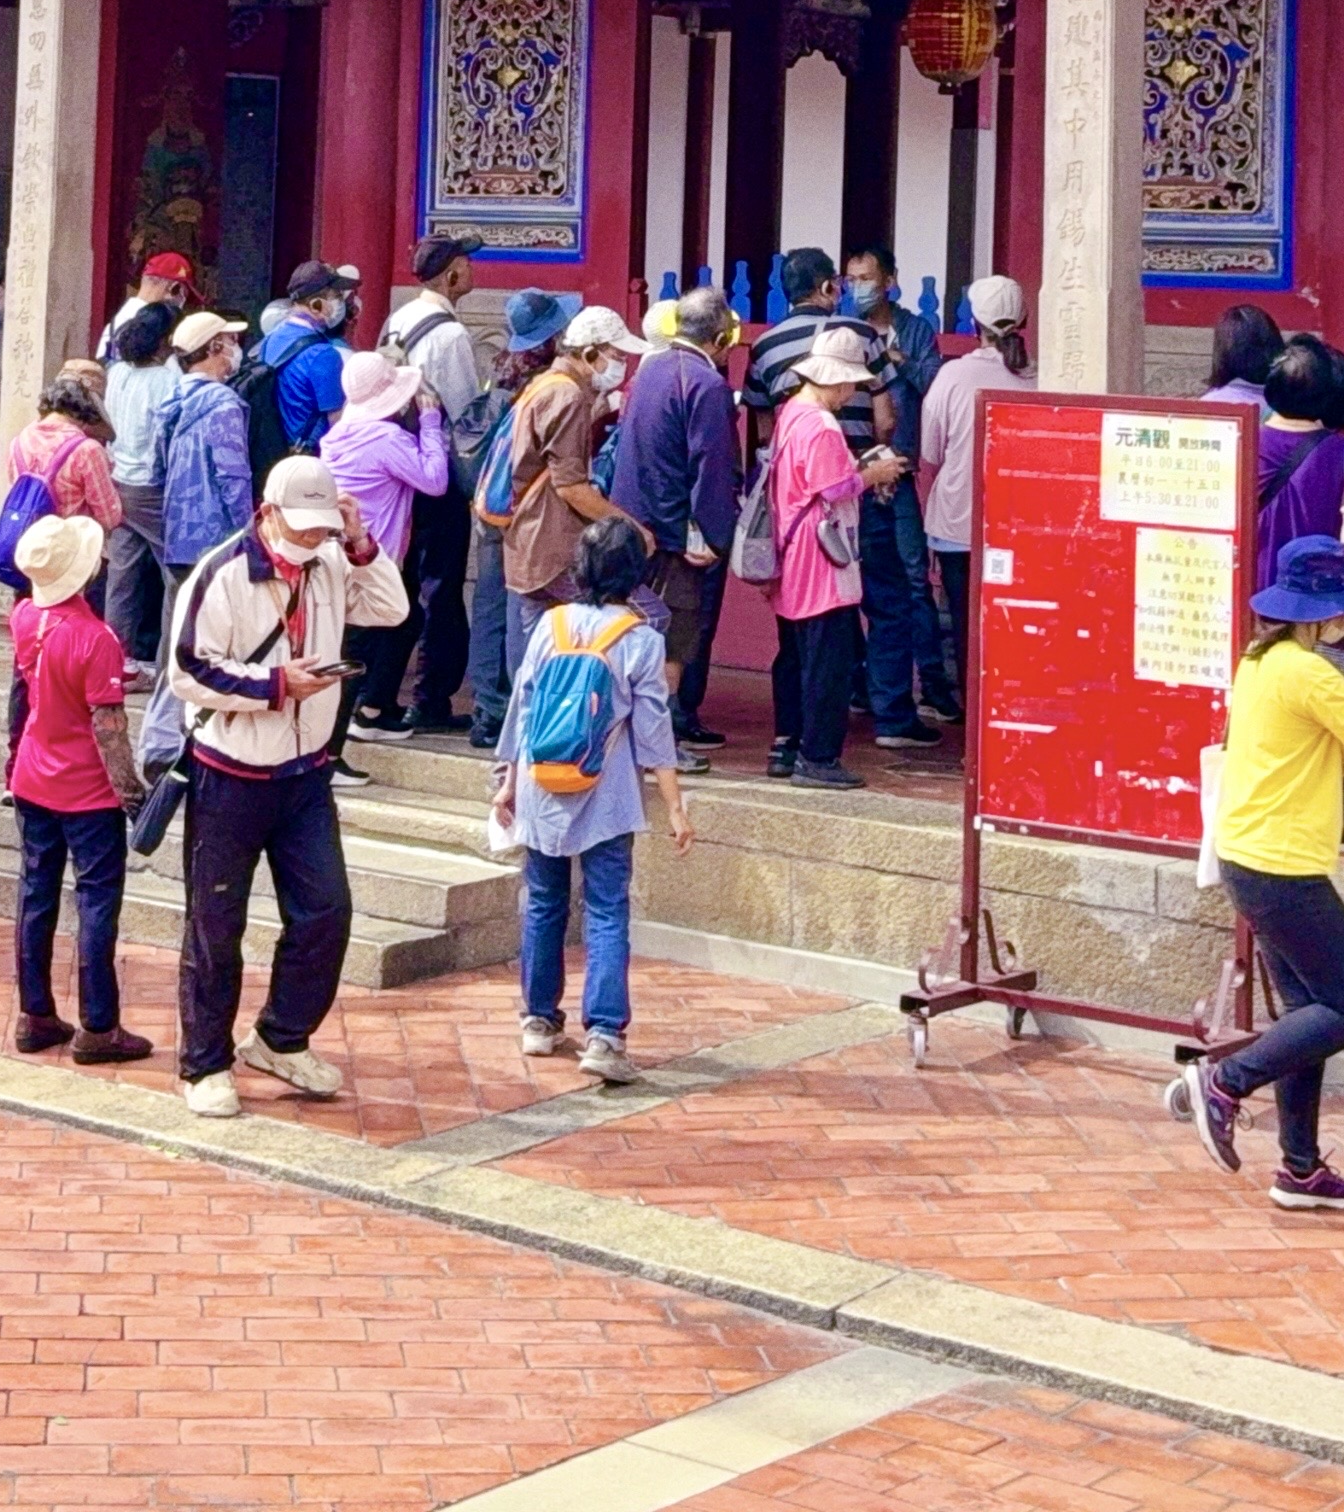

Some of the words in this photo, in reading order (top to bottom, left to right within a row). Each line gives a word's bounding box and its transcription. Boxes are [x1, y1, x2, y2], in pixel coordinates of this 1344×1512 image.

[1115, 426, 1171, 450] 元清觀
[1178, 437, 1222, 452] 開放時間
